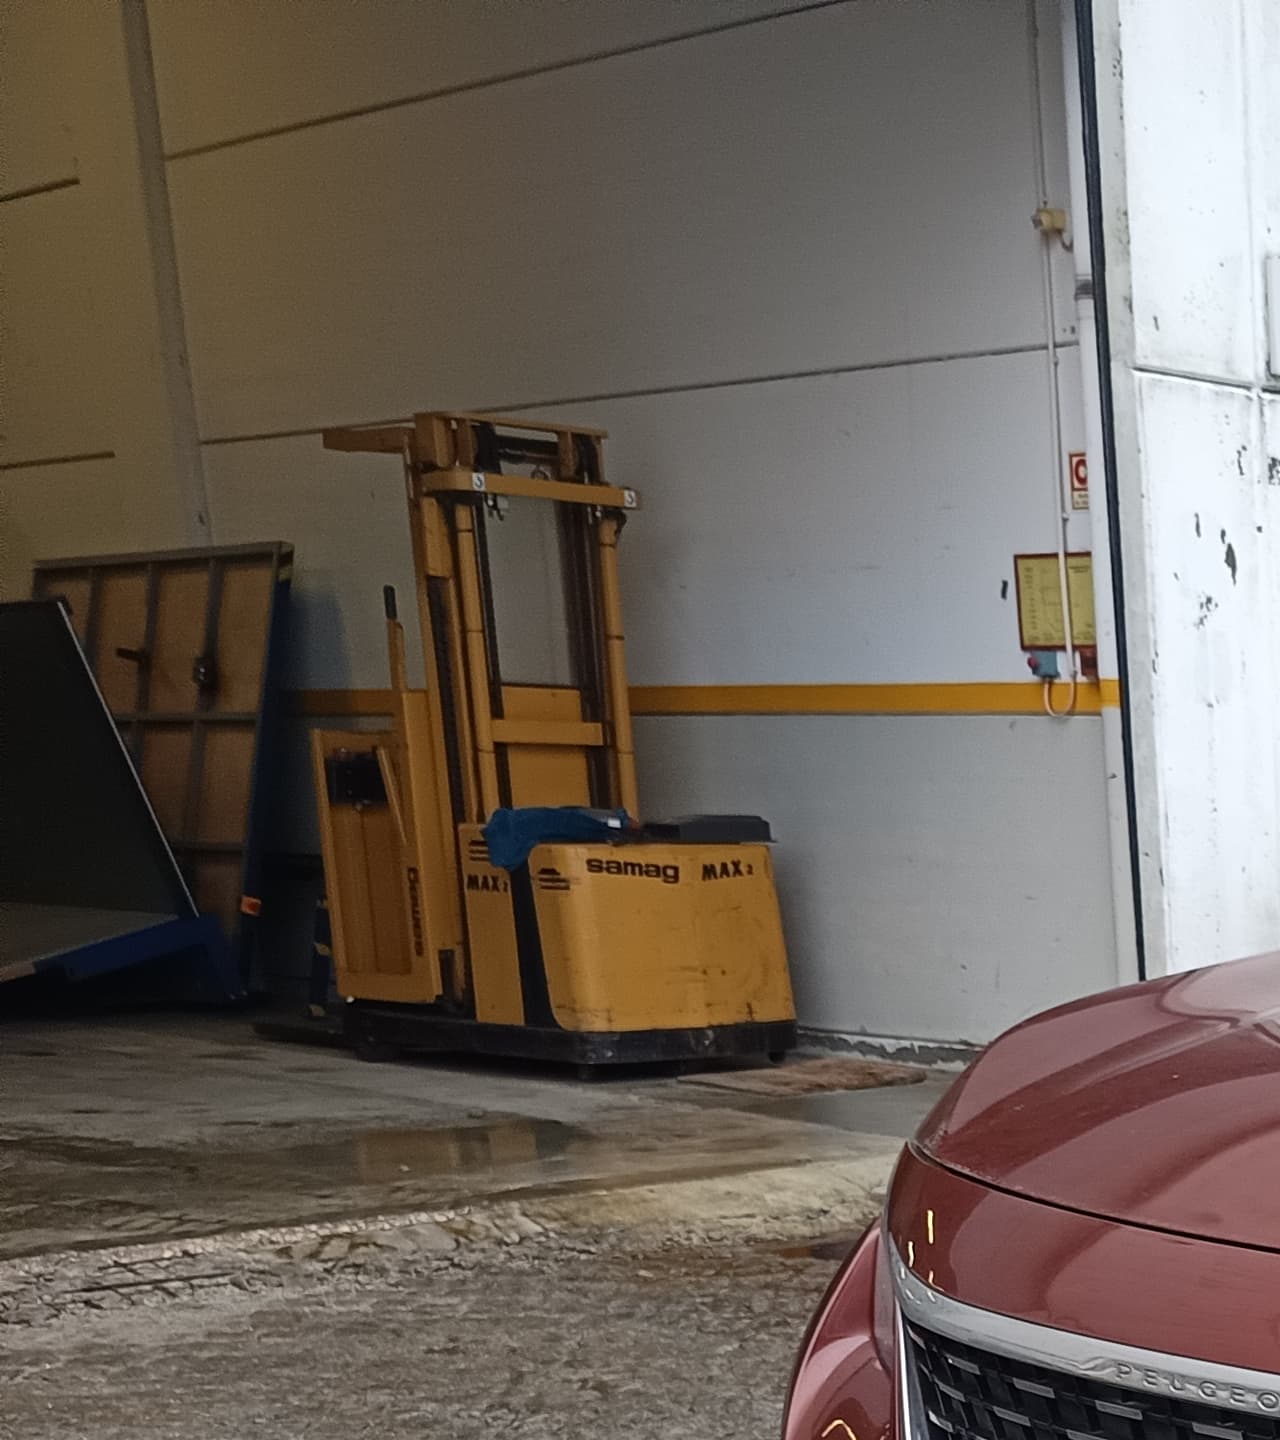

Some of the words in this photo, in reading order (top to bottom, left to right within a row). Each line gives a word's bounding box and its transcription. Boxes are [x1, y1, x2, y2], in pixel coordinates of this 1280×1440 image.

[586, 857, 680, 884] samag
[702, 859, 744, 882] MAX
[466, 874, 500, 893] MAX
